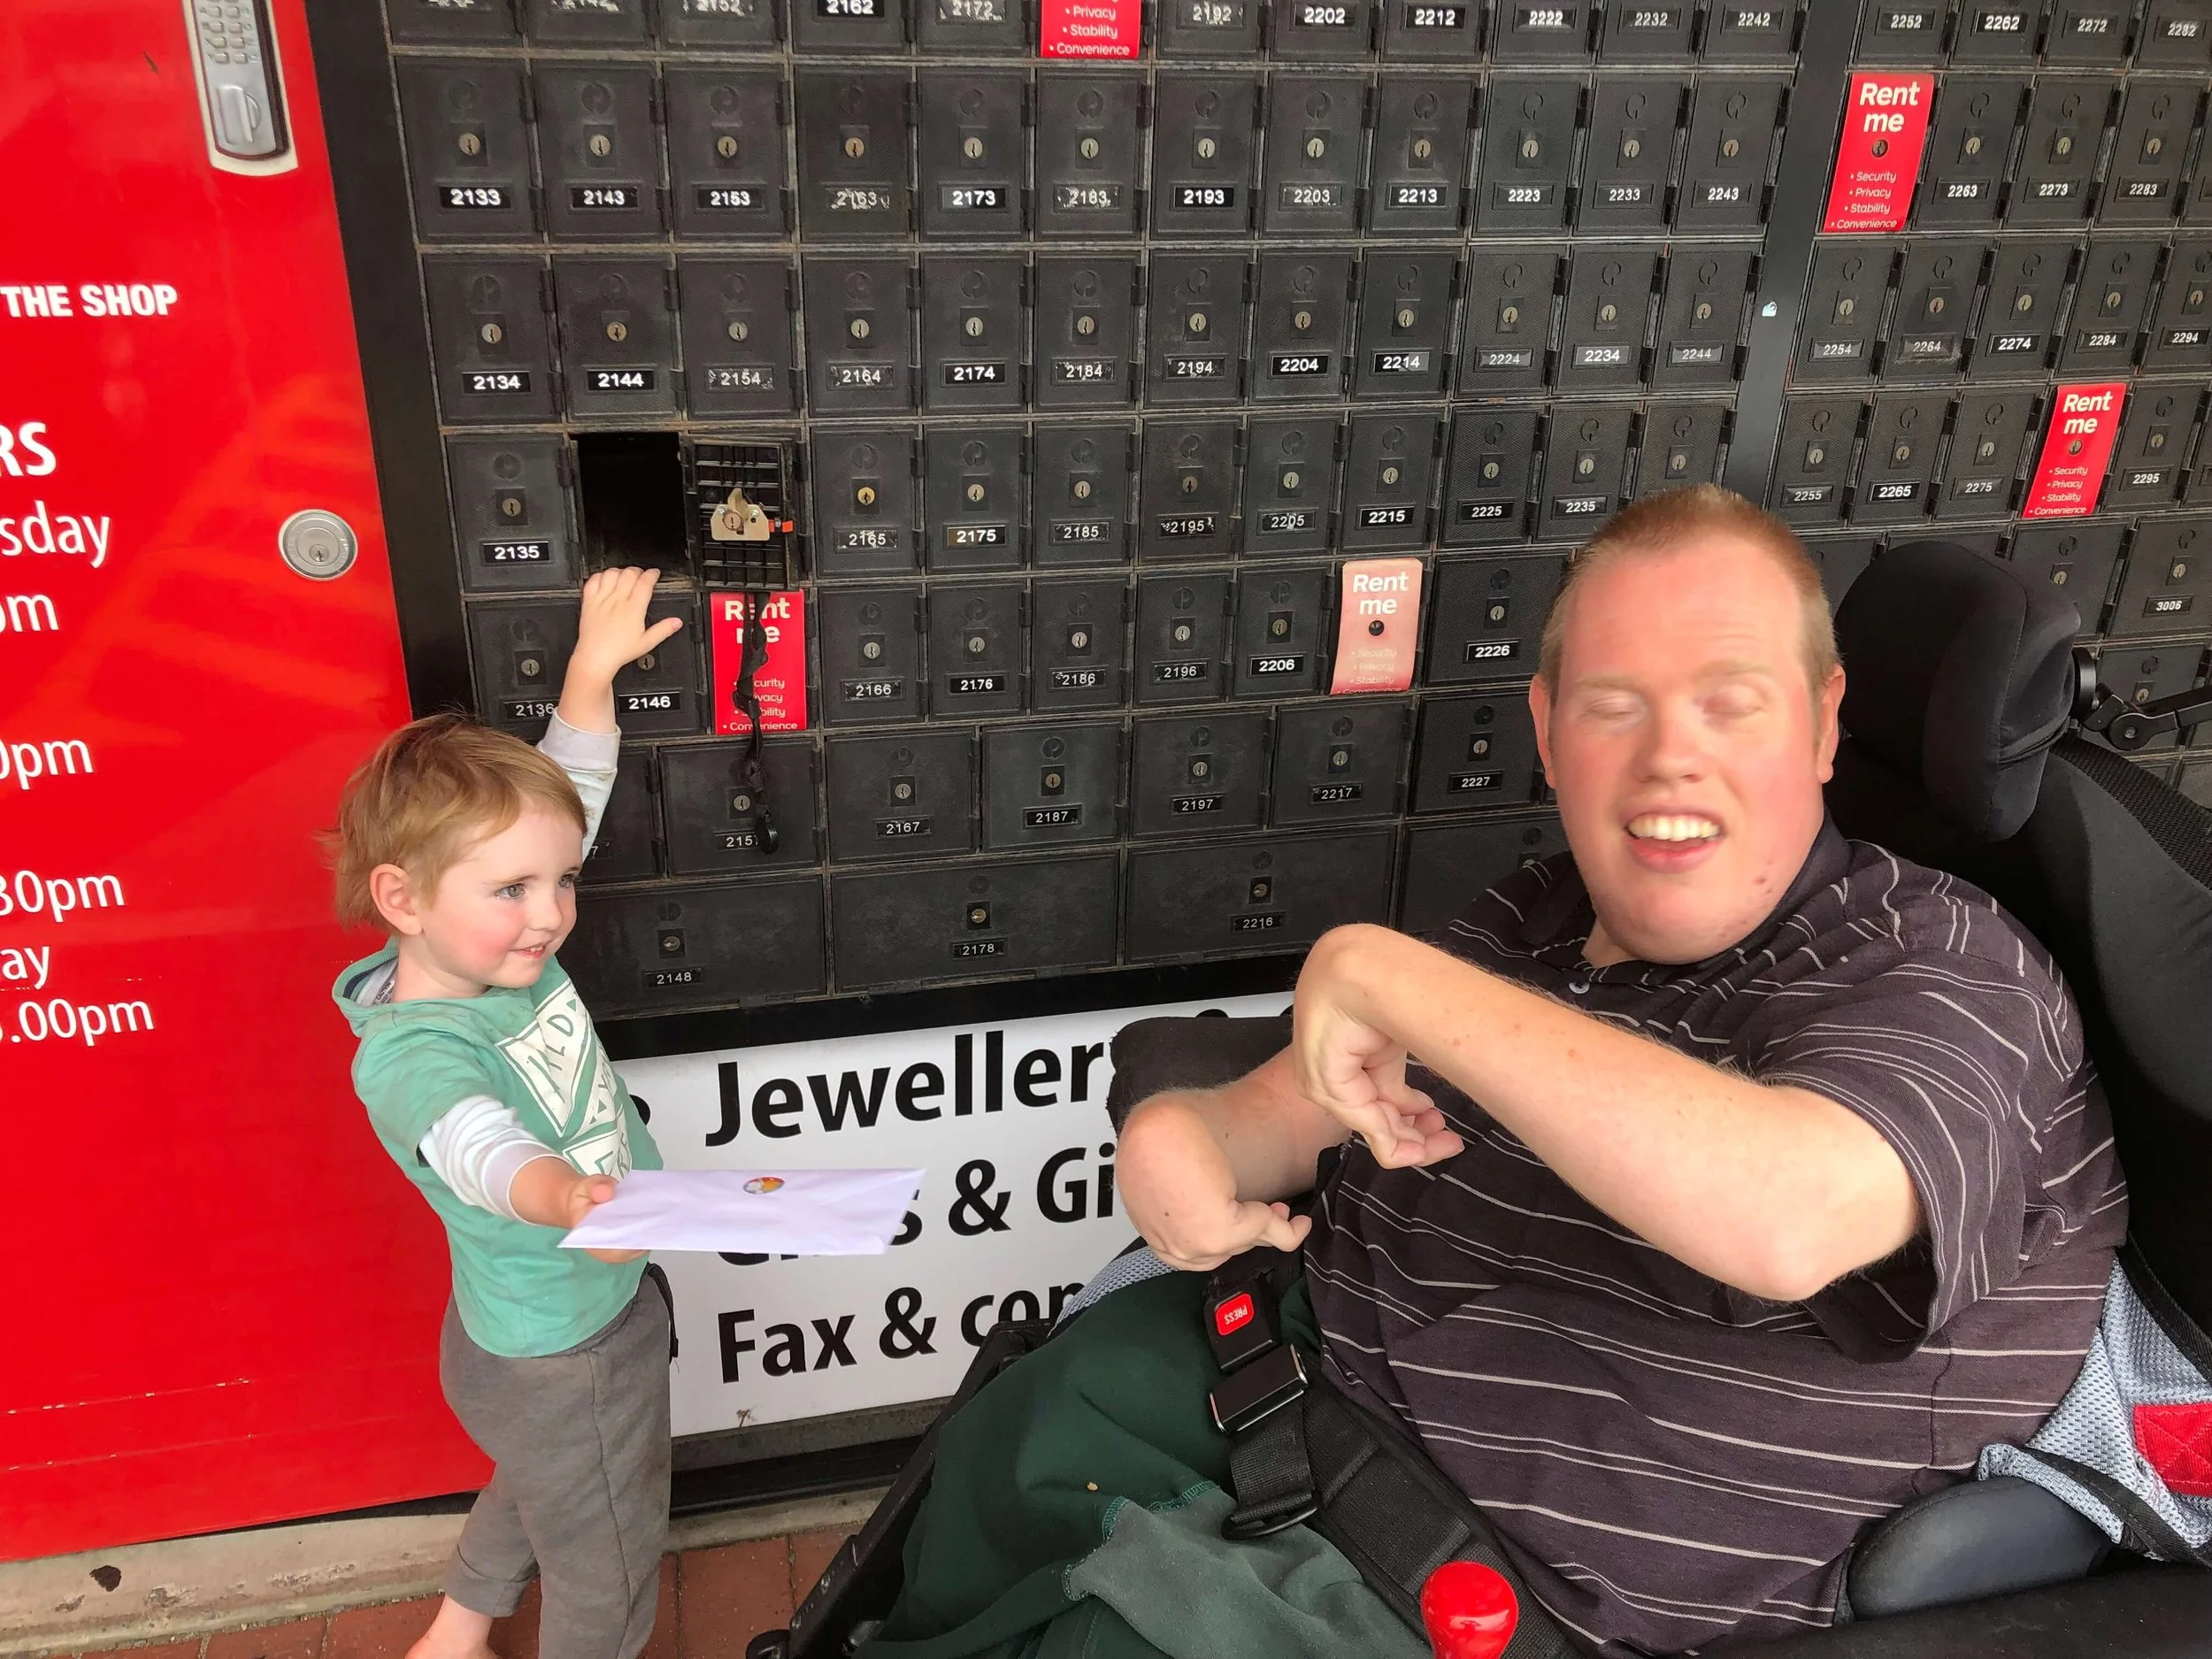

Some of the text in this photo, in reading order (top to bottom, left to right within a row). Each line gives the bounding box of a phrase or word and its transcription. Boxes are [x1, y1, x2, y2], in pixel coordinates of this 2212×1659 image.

[826, 0, 873, 14] 2162
[1073, 7, 1116, 20] Privacy
[1304, 8, 1345, 24] 2202
[1415, 9, 1455, 27] 2212
[1529, 10, 1563, 26] 2222
[1635, 12, 1668, 27] 2232
[1738, 12, 1770, 27] 2242
[1891, 15, 1922, 29] 2252
[1985, 16, 2020, 30] 2262
[1071, 25, 1118, 39] Stability
[2077, 19, 2108, 33] 2272
[2167, 22, 2196, 37] 2282
[1056, 42, 1130, 55] Convenience
[1859, 81, 1920, 106] Rent
[1863, 112, 1904, 133] me
[1856, 171, 1896, 183] Security
[1184, 189, 1225, 204] 2193
[1294, 189, 1331, 204] 2203
[1399, 188, 1438, 204] 2213
[1509, 188, 1540, 203] 2223
[1609, 188, 1640, 202] 2233
[1708, 187, 1740, 201] 2243
[1855, 187, 1892, 199] Privacy
[1947, 184, 1978, 197] 2263
[2039, 183, 2068, 196] 2273
[2129, 183, 2157, 196] 2283
[450, 189, 500, 205] 2133
[584, 190, 625, 205] 2143
[710, 191, 750, 205] 2153
[953, 190, 995, 205] 2173
[1069, 190, 1106, 204] 2183
[1850, 202, 1890, 215] Stability
[1837, 218, 1897, 229] Convenience
[0, 284, 178, 318] THE SHOP
[1998, 337, 2032, 349] 2274
[2089, 334, 2116, 345] 2284
[2172, 332, 2199, 344] 2294
[1682, 348, 1712, 360] 2244
[1823, 344, 1852, 356] 2254
[1913, 341, 1940, 353] 2264
[1382, 356, 1420, 370] 2214
[1489, 353, 1520, 365] 2224
[1585, 349, 1620, 363] 2234
[1066, 365, 1102, 379] 2184
[1177, 361, 1212, 374] 2194
[1280, 357, 1318, 373] 2204
[720, 373, 760, 386] 2154
[842, 369, 880, 383] 2164
[954, 366, 995, 380] 2174
[473, 375, 520, 390] 2134
[597, 373, 643, 388] 2144
[2062, 390, 2113, 412] Rent
[2063, 417, 2098, 434] me
[2054, 465, 2088, 477] Security
[2052, 479, 2083, 489] Privacy
[2133, 472, 2160, 485] 2295
[1878, 486, 1911, 498] 2265
[1965, 482, 1993, 494] 2275
[1793, 489, 1822, 502] 2255
[2047, 492, 2081, 503] Stability
[1471, 505, 1502, 518] 2225
[1566, 501, 1596, 513] 2235
[2034, 505, 2086, 515] Convenience
[1369, 510, 1405, 524] 2215
[1064, 526, 1099, 539] 2185
[1171, 520, 1204, 533] 2195
[956, 530, 996, 542] 2175
[495, 546, 540, 559] 2135
[1353, 572, 1409, 593] Rent
[1359, 597, 1397, 615] me
[2155, 600, 2182, 611] 3006
[1475, 645, 1510, 658] 2226
[1164, 665, 1197, 678] 2196
[1259, 659, 1295, 672] 2206
[960, 679, 993, 691] 2176
[1062, 672, 1096, 685] 2186
[856, 683, 892, 696] 2166
[629, 696, 671, 710] 2146
[516, 703, 555, 718] 2136
[1462, 776, 1491, 788] 2227
[1322, 787, 1352, 800] 2217
[1181, 799, 1214, 812] 2197
[1035, 810, 1069, 824] 2187
[887, 821, 920, 835] 2167
[726, 835, 758, 848] 215
[1242, 916, 1273, 929] 2216
[962, 942, 995, 956] 2178
[657, 972, 692, 985] 2148
[0, 998, 156, 1047] .00pm
[705, 1030, 1112, 1147] Jeweller
[949, 1159, 1011, 1236] &
[1225, 1304, 1248, 1325] PRESS
[718, 1309, 858, 1384] Fax
[879, 1286, 938, 1359] &
